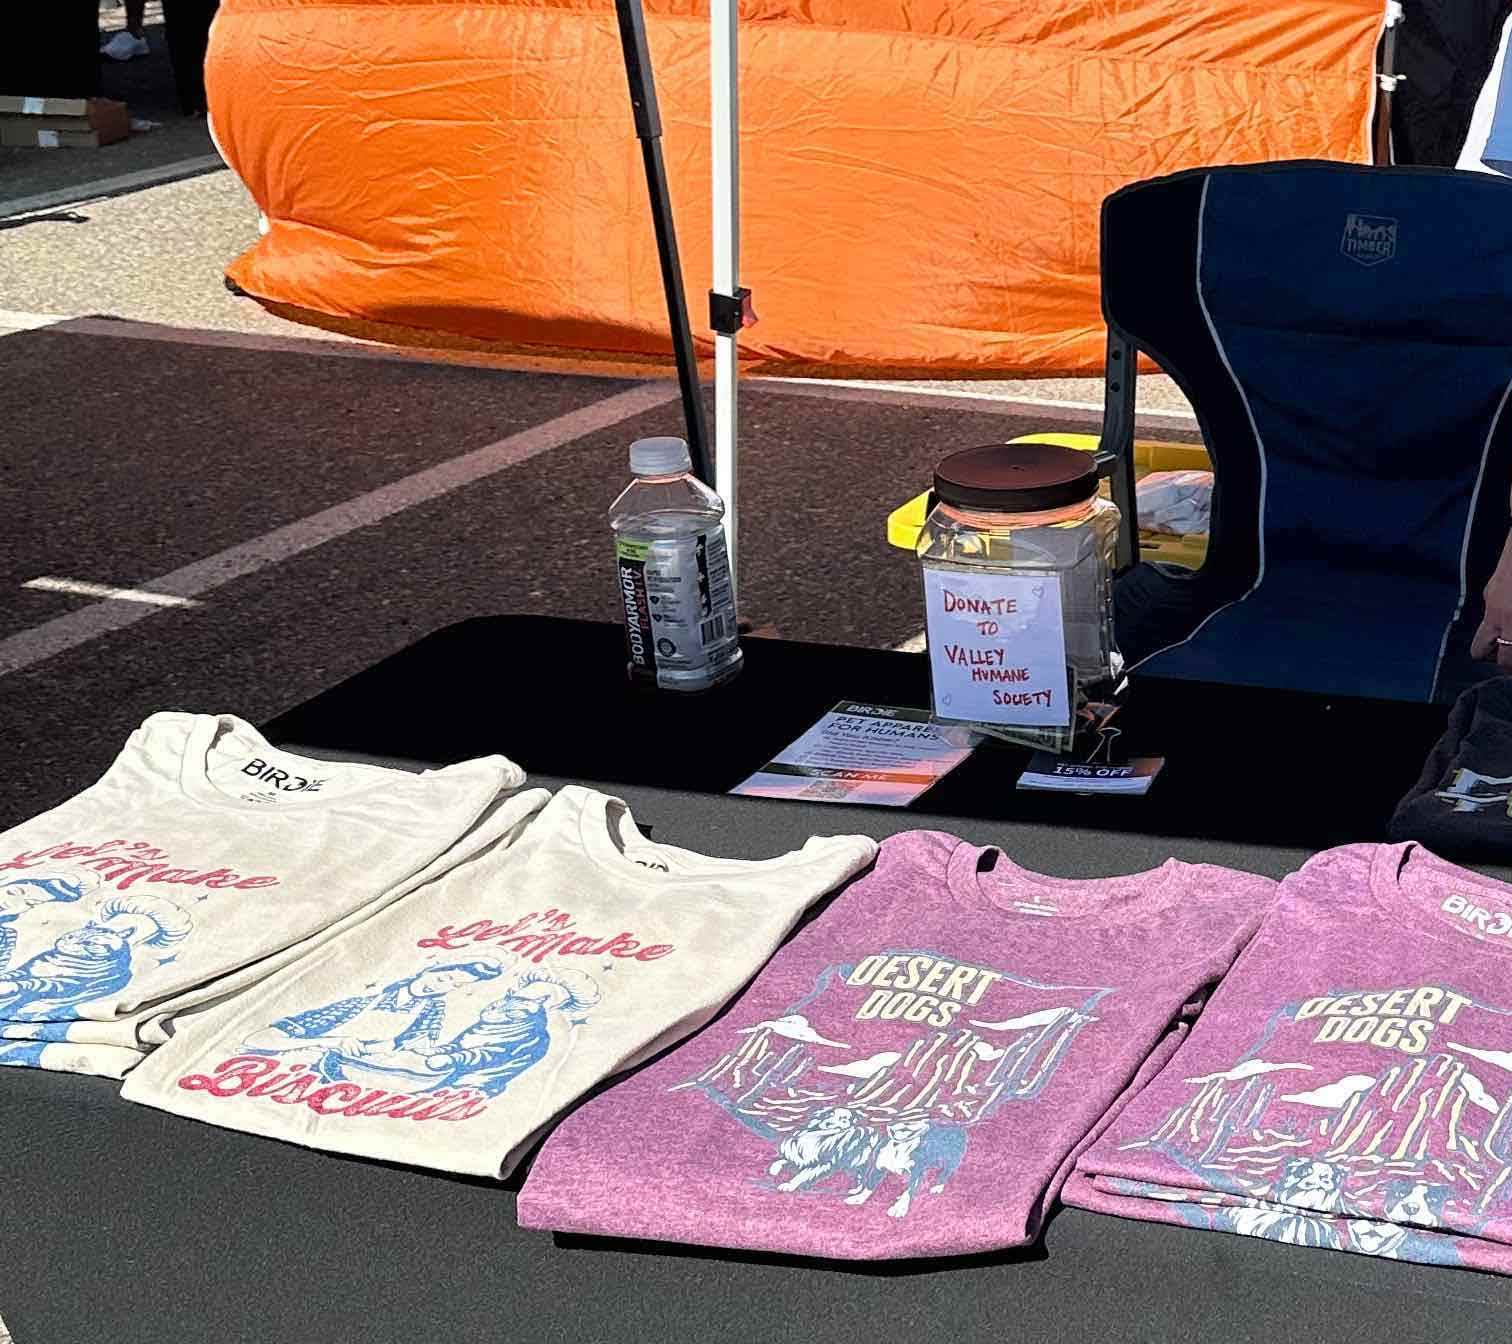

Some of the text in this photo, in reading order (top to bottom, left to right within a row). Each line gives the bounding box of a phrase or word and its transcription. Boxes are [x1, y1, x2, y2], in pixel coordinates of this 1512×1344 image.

[620, 566, 646, 666] BODYARMOR
[943, 589, 1018, 616] DONATE
[976, 620, 999, 637] TO
[943, 644, 1004, 666] VALLEY
[971, 667, 1031, 683] HUMANE
[835, 715, 866, 726] PET
[845, 704, 899, 717] BIRDIE
[827, 722, 940, 742] FOR HUMANS
[240, 758, 328, 793] BIRDIE
[807, 767, 890, 782] SCAN ME
[1051, 766, 1134, 777] 15% OFF
[78, 857, 281, 890] Make
[496, 931, 676, 963] Make
[845, 955, 1003, 1005] DESERT
[855, 989, 962, 1028] DOGS
[1294, 986, 1473, 1025] DESERT
[1312, 1015, 1435, 1054] DOGS
[177, 1054, 490, 1121] Biscuits
